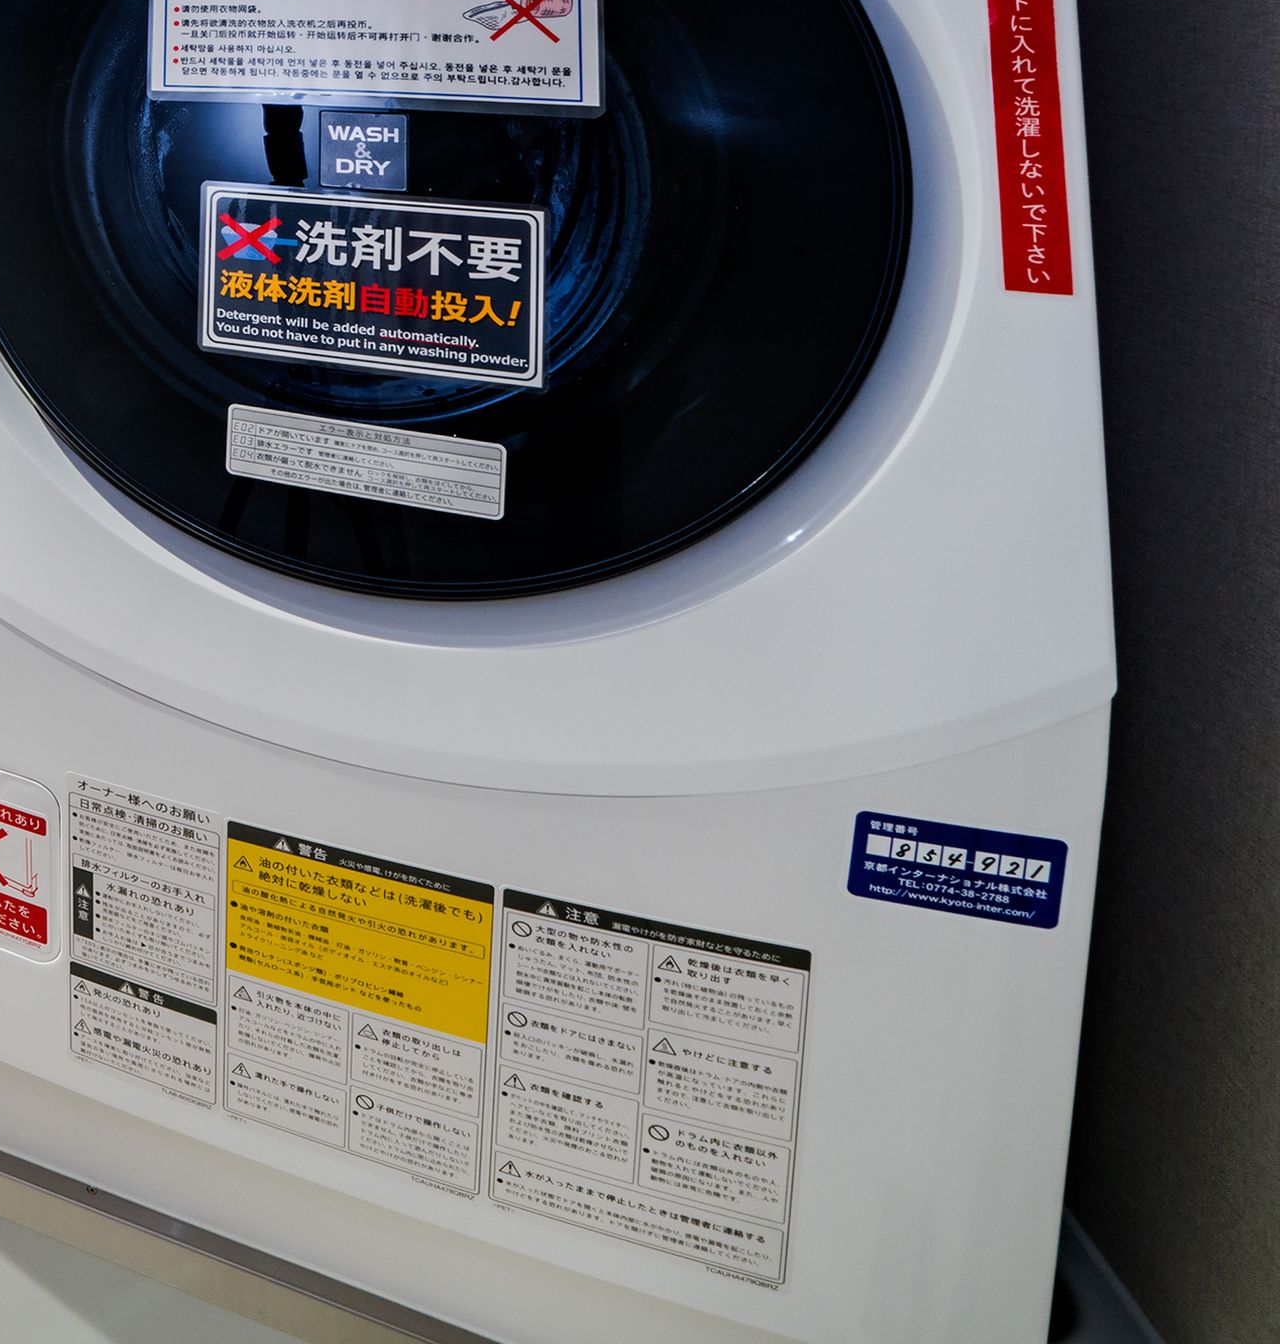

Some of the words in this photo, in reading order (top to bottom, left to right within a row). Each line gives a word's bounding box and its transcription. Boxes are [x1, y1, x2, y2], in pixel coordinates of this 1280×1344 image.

[327, 124, 400, 143] WASH
[354, 141, 372, 159] &
[335, 158, 392, 176] DRY
[295, 218, 523, 283] 洗剤不要
[219, 269, 522, 327] 液体洗剤自動投入!
[216, 308, 282, 327] Detergent
[285, 315, 308, 329] will
[312, 318, 329, 331] be
[332, 320, 376, 337] added
[379, 327, 479, 349] automatically.
[232, 422, 255, 434] E02
[257, 426, 330, 446] ドアが開いています
[232, 434, 255, 446] E03
[257, 439, 314, 456] 排水エラーです
[77, 779, 211, 825] オーナー様へのお願い
[79, 798, 208, 843] 日常点検・清掃のお願い
[870, 819, 920, 837] 管理番号
[297, 842, 329, 862] 警告
[80, 858, 206, 904] 排水フィルターのお手入れ
[257, 870, 368, 909] 絶対に乾燥しない
[258, 856, 484, 925] 油の付いた衣類などは(洗濯後でも)
[339, 857, 451, 893] 火災や感電、けがを防ぐために
[863, 860, 1049, 900] 京都インターナショナル株式会社
[897, 877, 1011, 905] TEL:0774-38-2788
[105, 882, 195, 917] 水漏れの恐れあり
[564, 906, 600, 926] 注意
[869, 883, 1037, 919] http://www.kyoto-inter.com/
[241, 884, 474, 955] 油の酸化熱による自然発火や引火の恐れがあります。
[535, 924, 635, 954] 大型の物や防水性の
[611, 920, 781, 964] 漏電やけがを防ぎ家財などを守るために
[686, 957, 793, 988] 乾燥後は衣類を早く
[92, 988, 161, 1018] 発火の恐れあり
[138, 985, 165, 1006] 警告
[92, 1026, 212, 1076] 感電や漏電火災の恐れあり
[681, 1047, 773, 1076] やけどに注意する
